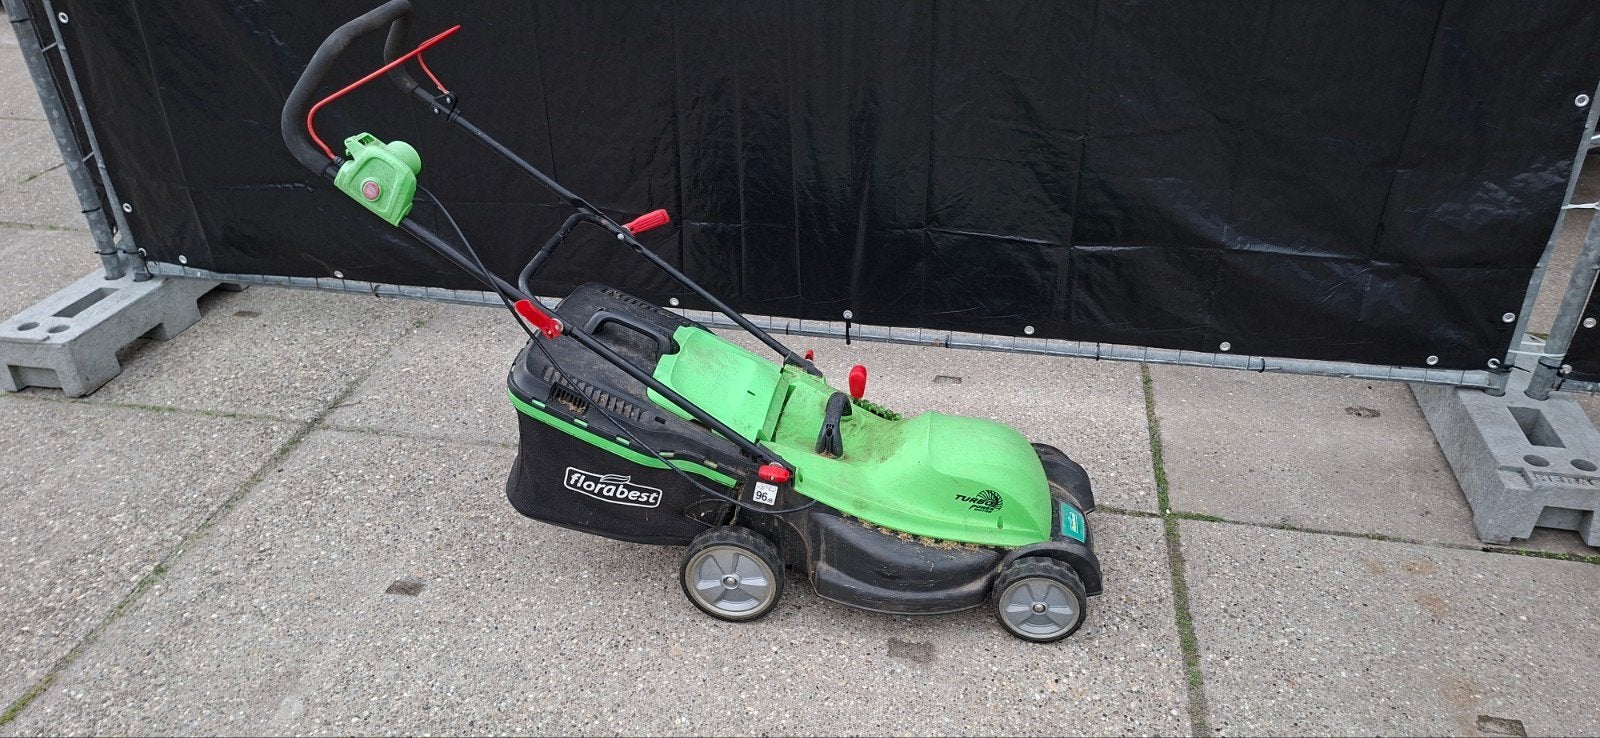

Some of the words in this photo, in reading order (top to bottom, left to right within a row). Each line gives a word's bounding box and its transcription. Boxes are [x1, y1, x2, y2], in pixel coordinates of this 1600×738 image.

[569, 473, 659, 503] florabest
[755, 490, 768, 502] 96
[954, 494, 994, 506] TURBO
